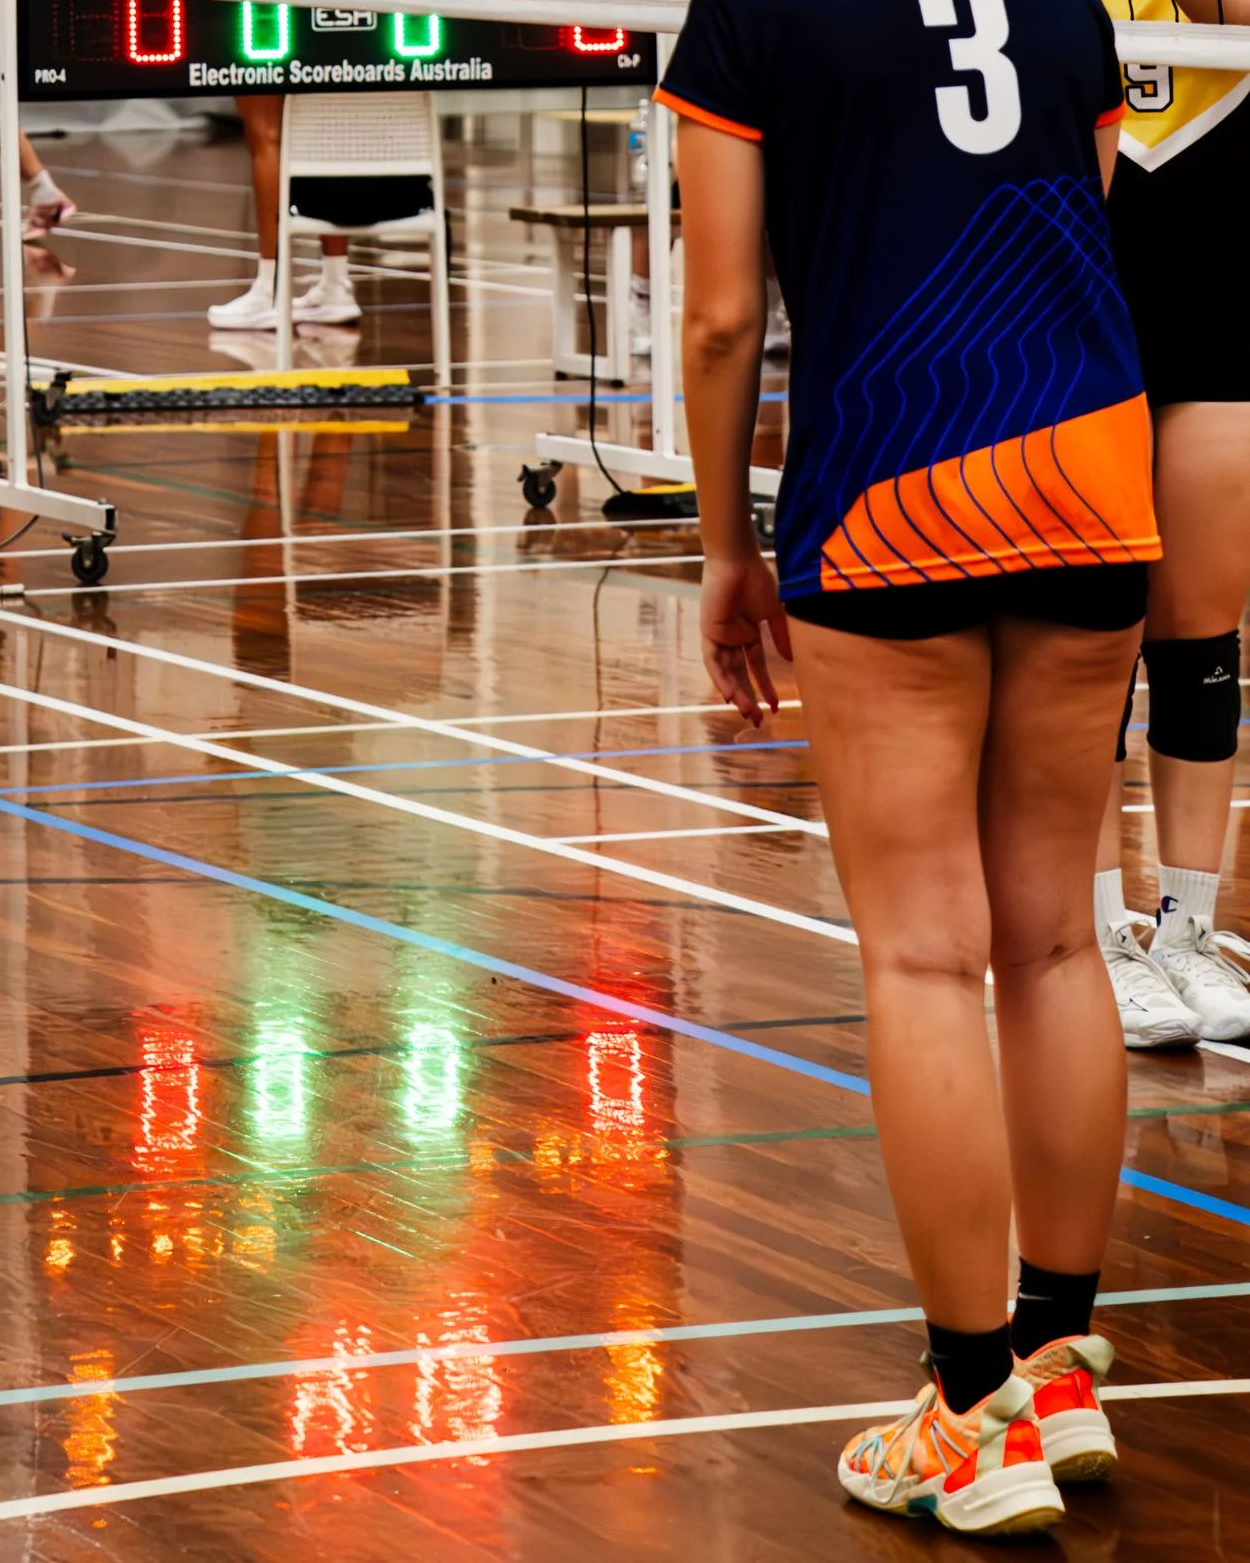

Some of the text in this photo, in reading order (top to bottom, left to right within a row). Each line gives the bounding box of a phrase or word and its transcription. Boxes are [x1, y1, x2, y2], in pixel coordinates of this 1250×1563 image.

[188, 56, 494, 88] Electronic Scoreboards Australia
